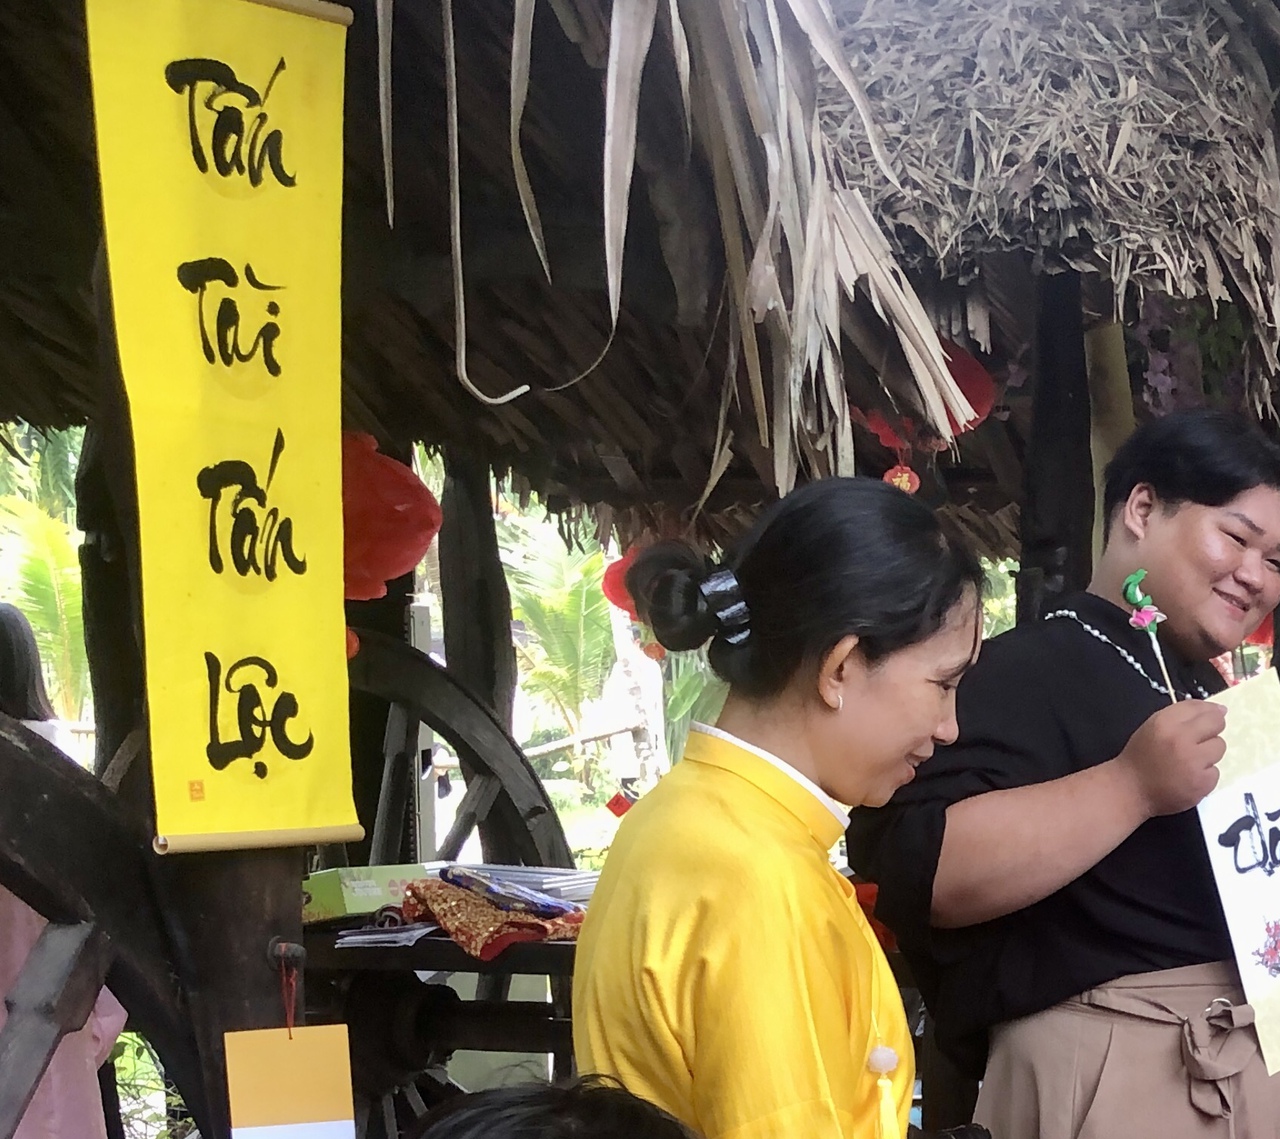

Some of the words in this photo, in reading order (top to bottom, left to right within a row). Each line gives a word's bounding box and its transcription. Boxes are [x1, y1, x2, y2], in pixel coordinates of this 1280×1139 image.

[177, 256, 287, 378] Tài
[197, 428, 307, 580] Tấn
[205, 650, 314, 780] Lộc
